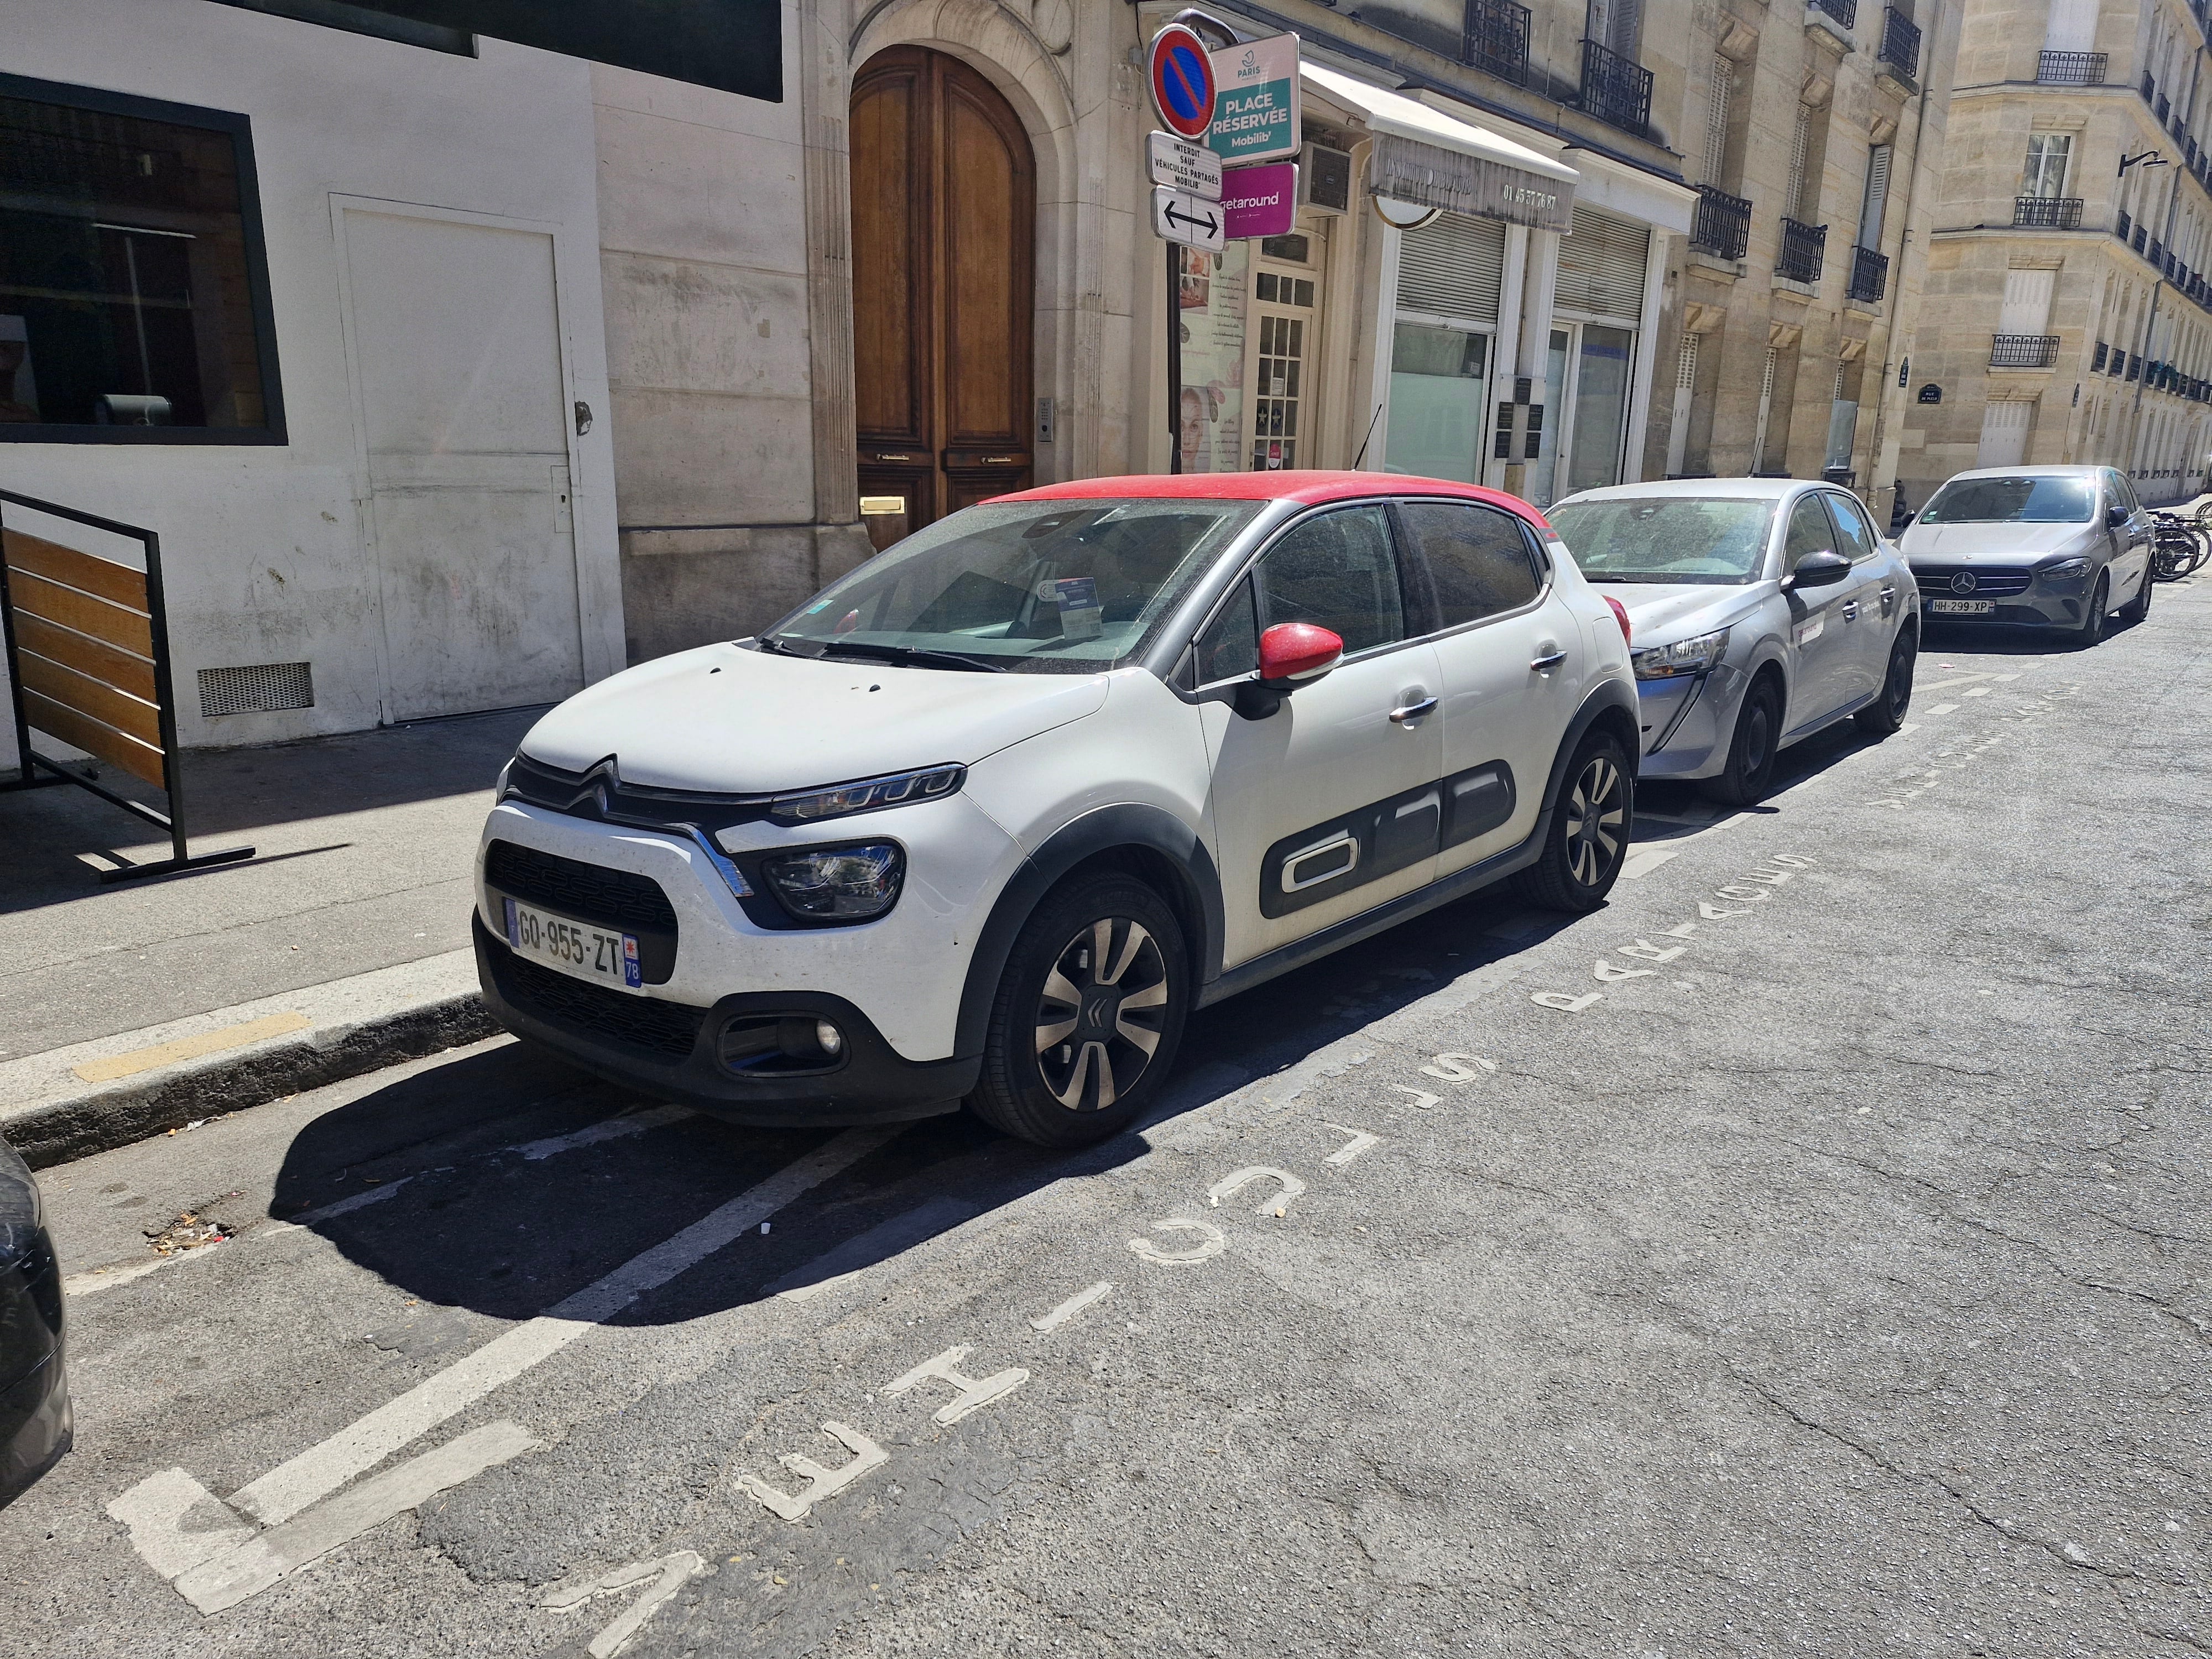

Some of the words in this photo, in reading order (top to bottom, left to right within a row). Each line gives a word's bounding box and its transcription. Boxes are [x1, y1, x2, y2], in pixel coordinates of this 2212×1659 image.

[1238, 66, 1260, 78] PARIS
[1225, 92, 1273, 114] PLACE
[1213, 106, 1287, 134] RÉSERVÉE
[1173, 143, 1200, 158] INTERDIT
[1180, 155, 1195, 166] SAUF
[1155, 158, 1188, 175] VÉHICULES
[1190, 169, 1219, 185] PARTAGÉS
[1504, 184, 1512, 201] 01
[1516, 187, 1525, 204] 45
[1547, 195, 1556, 210] 87
[1934, 601, 1987, 612] HH-299-XP
[519, 910, 620, 975] GQ-955-ZT
[625, 961, 639, 980] 78
